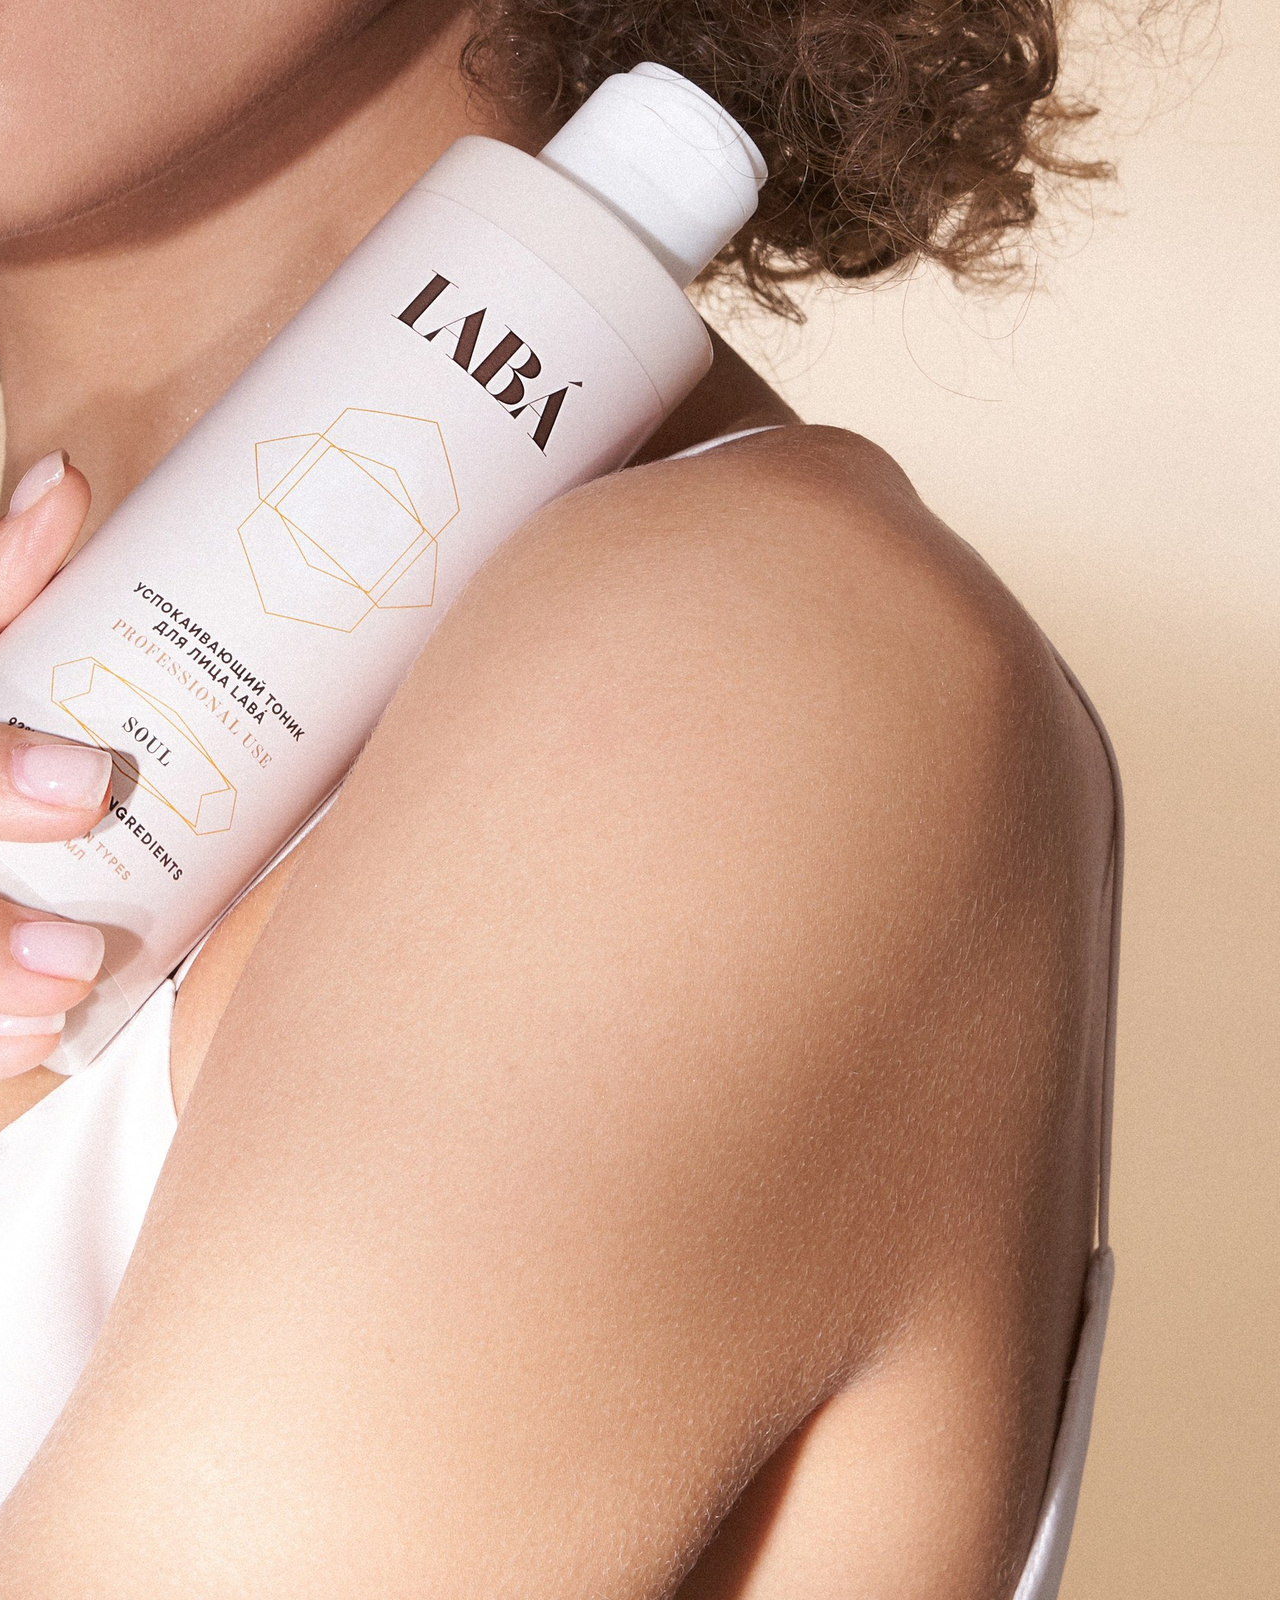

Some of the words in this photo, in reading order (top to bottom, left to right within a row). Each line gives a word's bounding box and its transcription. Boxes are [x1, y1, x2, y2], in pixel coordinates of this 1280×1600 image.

[391, 269, 583, 457] LABÁ
[112, 618, 239, 735] PROFESSIONAL
[242, 731, 272, 769] USE
[133, 581, 266, 696] УСПОКАИВАЮЩИЙ
[265, 693, 305, 741] ТОНИК
[152, 620, 188, 649] ДЛЯ
[186, 647, 229, 688] ЛИЦА
[122, 716, 172, 766] SOUL
[96, 841, 131, 880] TYPES
[109, 796, 183, 880] NGREDIENTS
